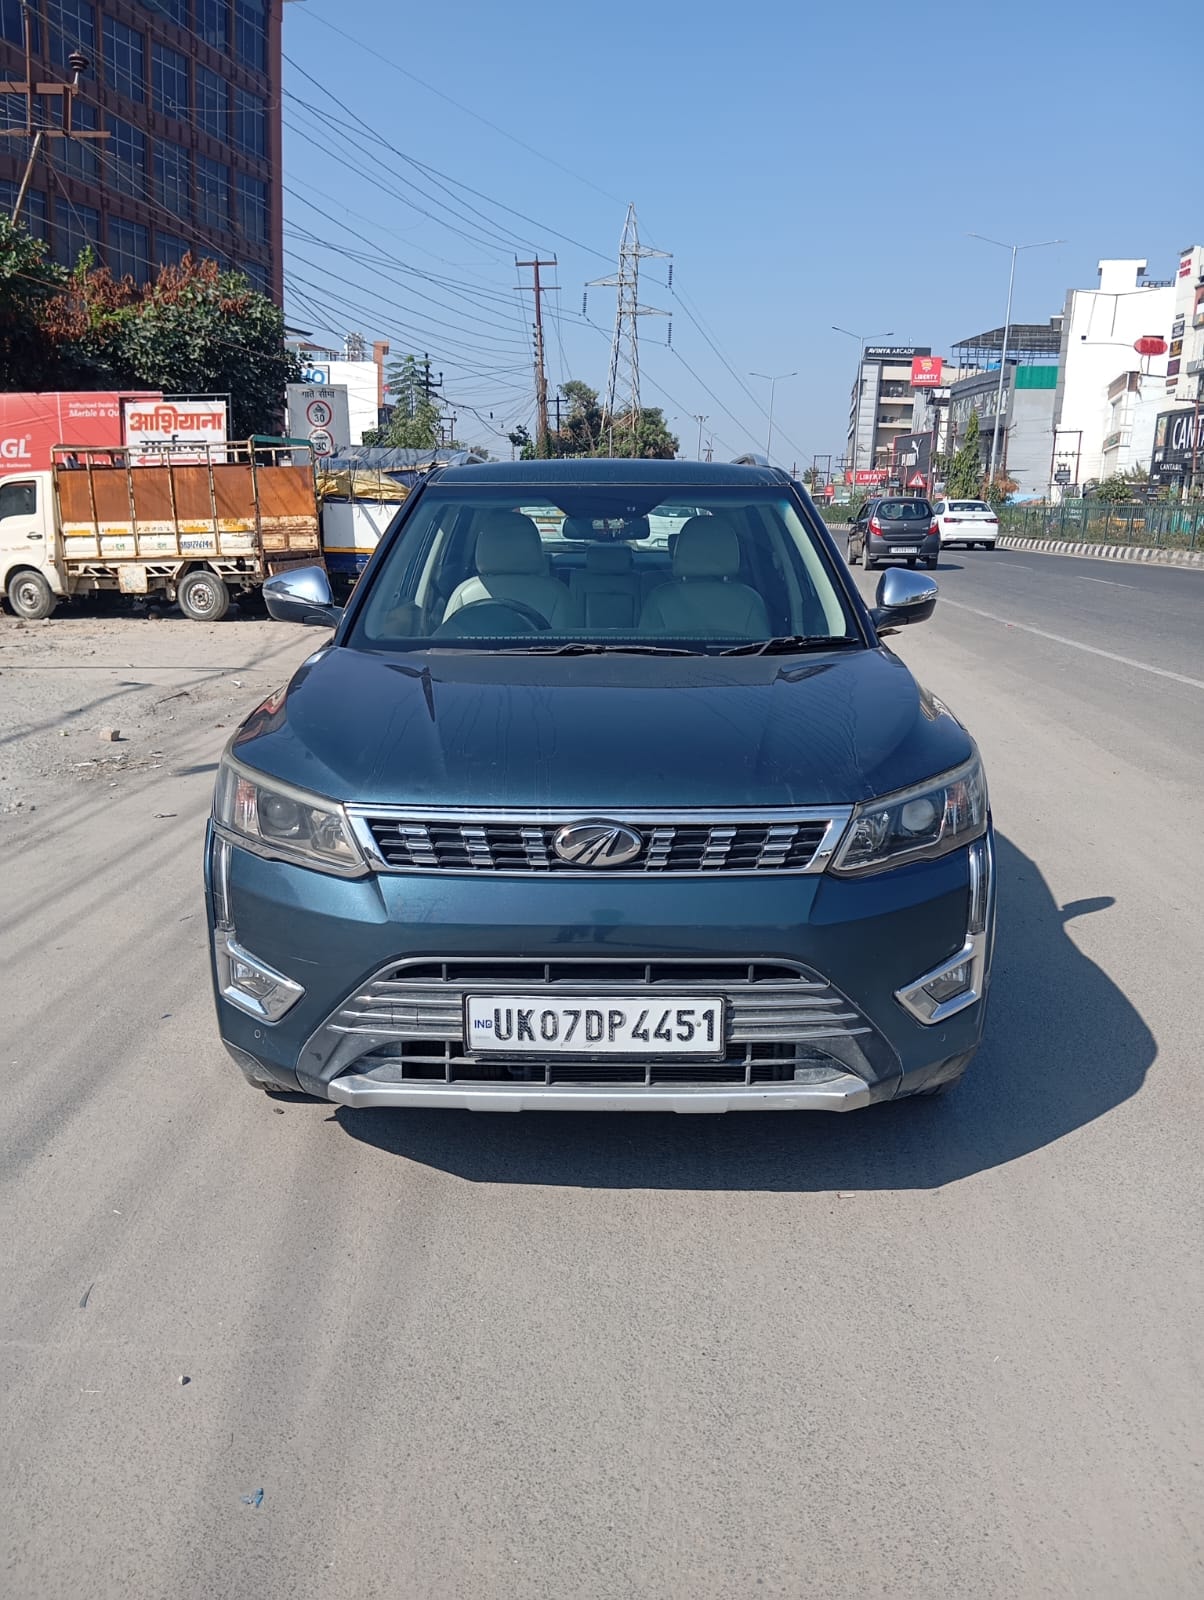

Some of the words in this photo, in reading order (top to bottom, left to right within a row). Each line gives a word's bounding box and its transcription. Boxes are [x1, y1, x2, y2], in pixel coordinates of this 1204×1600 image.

[69, 409, 97, 417] Marble
[99, 409, 105, 417] &
[130, 405, 223, 434] आशियाना
[314, 414, 325, 423] 30
[0, 438, 31, 459] GL
[316, 442, 326, 451] 30
[474, 1020, 493, 1029] IND
[493, 1008, 715, 1042] UK07DP4451
